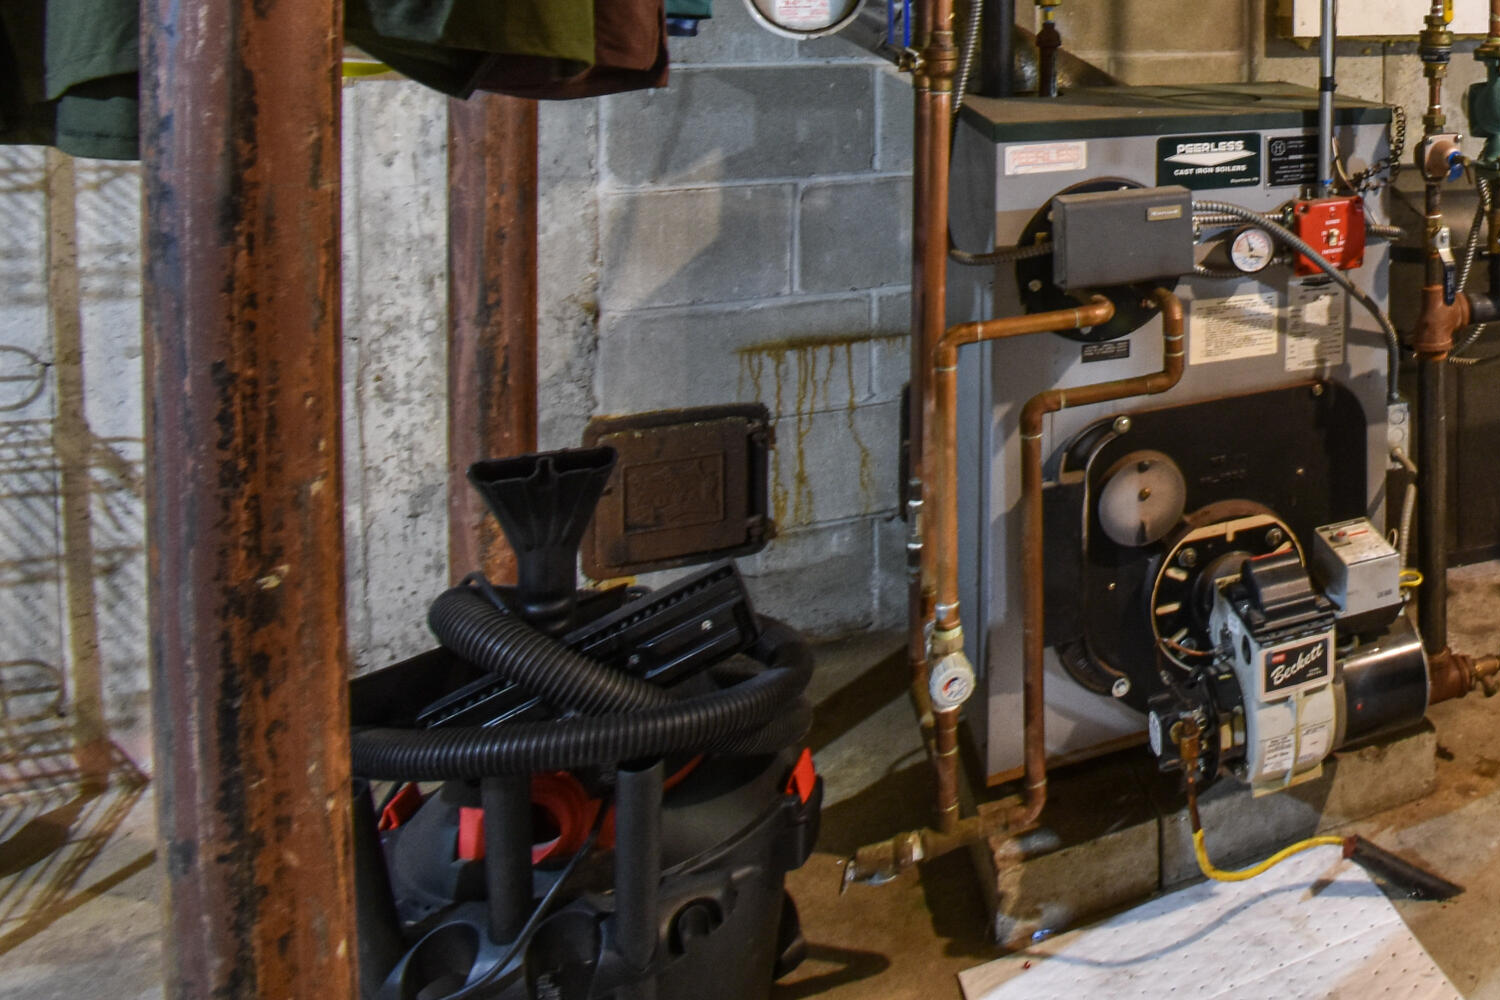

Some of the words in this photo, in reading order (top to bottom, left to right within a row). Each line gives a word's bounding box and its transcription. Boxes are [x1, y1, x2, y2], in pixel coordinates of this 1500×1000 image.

[1176, 140, 1245, 154] PEERLESS
[1173, 168, 1194, 177] CAST
[1195, 167, 1214, 175] IRON
[1215, 165, 1248, 174] BOILERS
[1270, 644, 1323, 686] Beckett
